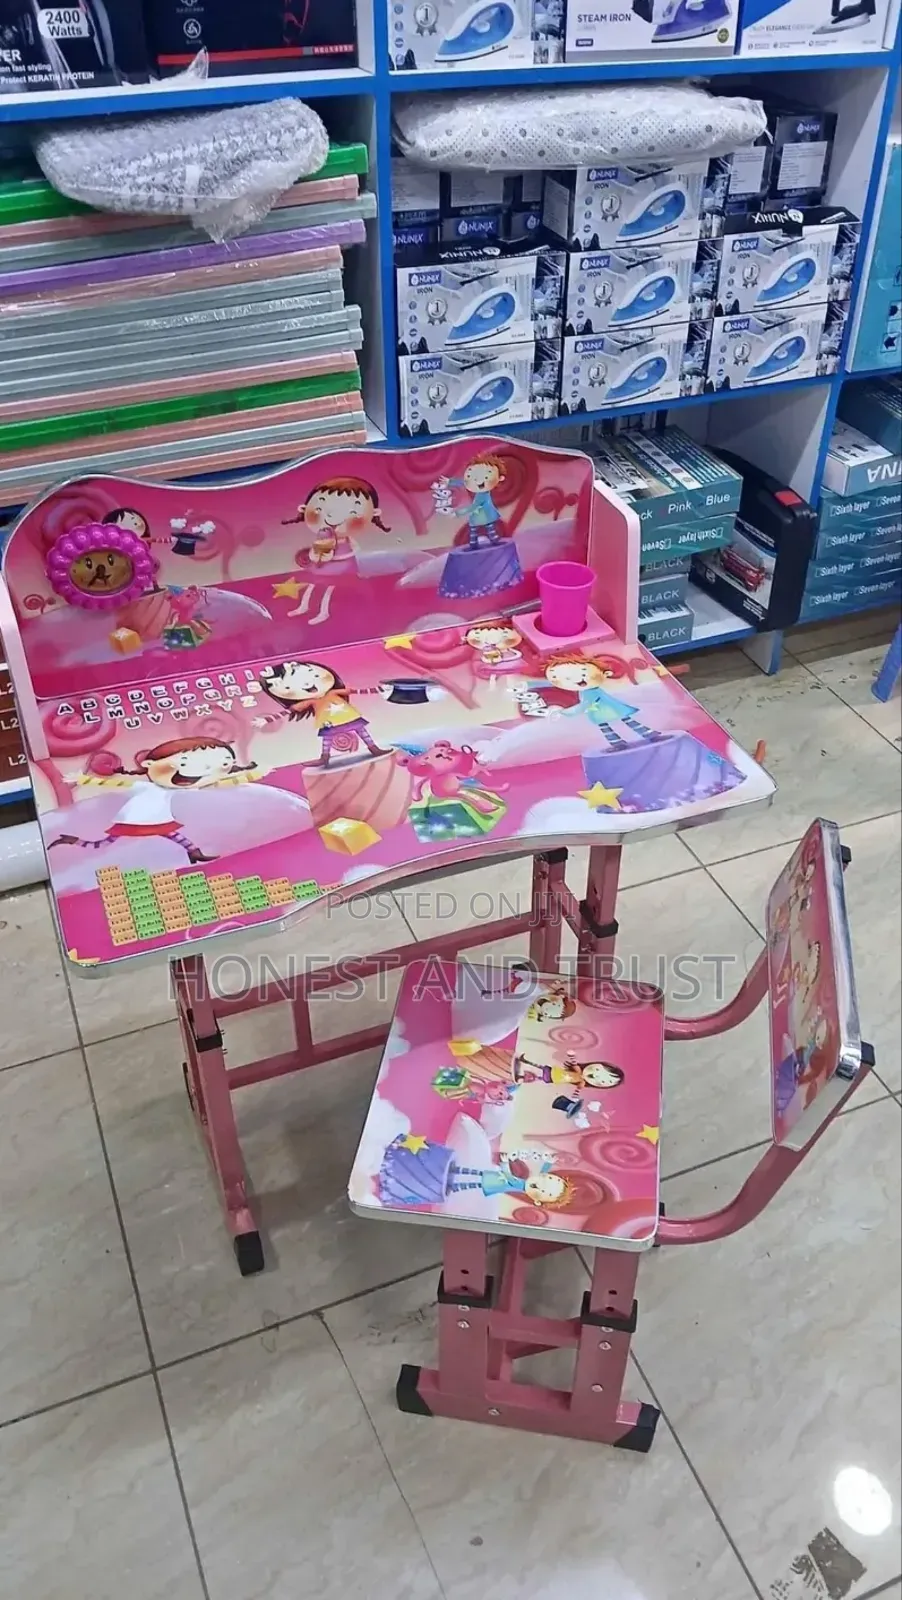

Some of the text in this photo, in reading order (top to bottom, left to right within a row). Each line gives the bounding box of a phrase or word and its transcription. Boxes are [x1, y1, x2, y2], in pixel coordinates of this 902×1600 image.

[45, 10, 80, 25] 2400
[577, 13, 631, 23] STEAM IRON
[48, 25, 82, 38] Watts
[27, 63, 52, 73] styling
[1, 71, 94, 84] Protect KERATIN PROTEIN
[467, 221, 494, 232] NUNIX
[396, 233, 423, 244] NUNIX
[668, 500, 692, 514] Pink
[706, 494, 731, 506] Blue
[835, 502, 853, 515] Sixth
[854, 501, 870, 512] layer
[678, 532, 697, 544] layer
[697, 528, 718, 542] Sixth
[831, 536, 848, 546] Sixth
[849, 532, 865, 543] layer
[877, 527, 896, 536] Seven
[645, 556, 684, 572] BLACK
[820, 566, 838, 577] Sixth
[839, 562, 855, 574] layer
[865, 557, 884, 567] Seven
[641, 589, 680, 604] BLACK
[814, 580, 895, 605] Sixth layer Seven layer
[648, 627, 687, 641] BLACK
[58, 703, 74, 715] A
[80, 698, 97, 710] B
[128, 690, 144, 701] D
[151, 685, 168, 697] E
[173, 681, 188, 694] F
[196, 677, 213, 689] G
[218, 673, 235, 685] H
[84, 712, 100, 723] L
[107, 706, 125, 719] M
[133, 701, 150, 714] N
[180, 693, 196, 705] P
[224, 685, 242, 697] R
[124, 695, 257, 730] U V W X Y Z
[1, 717, 19, 730] L2
[8, 754, 27, 767] L2
